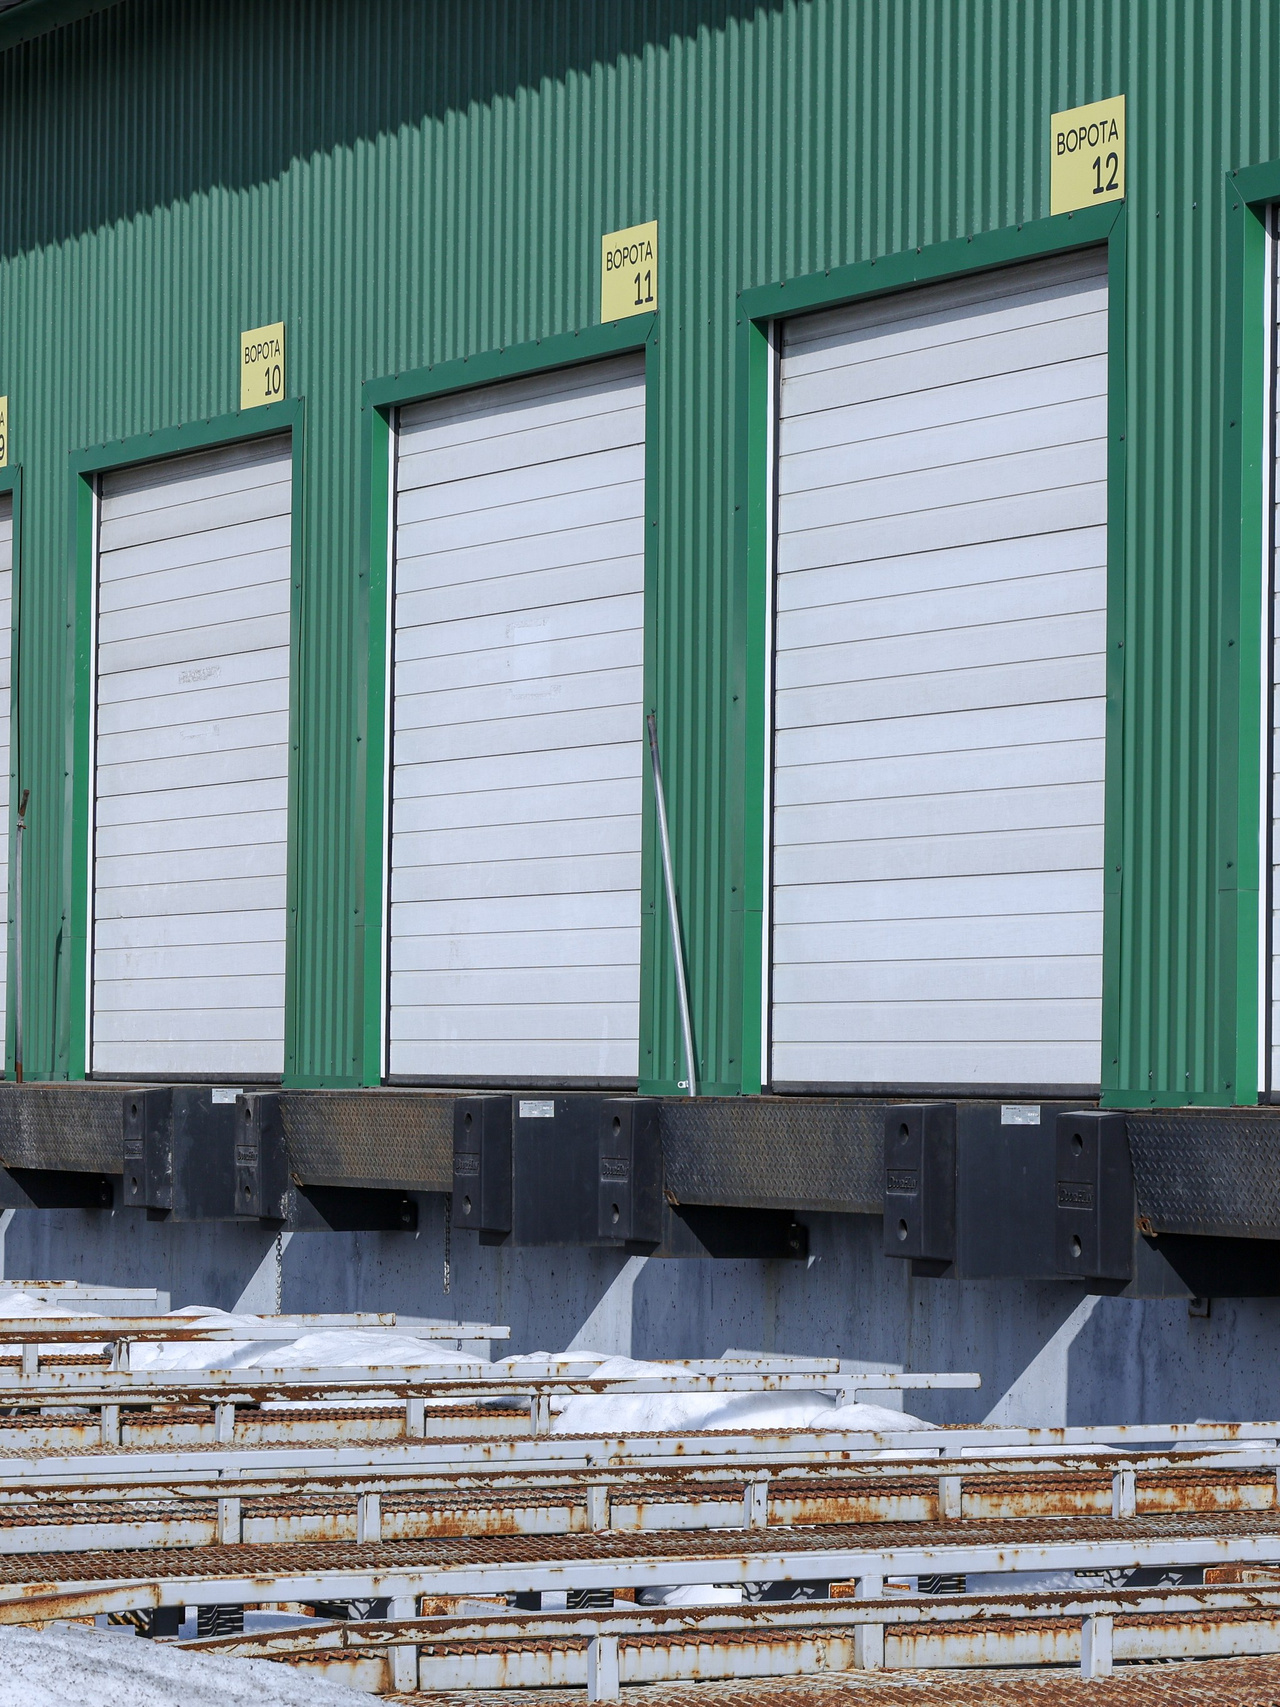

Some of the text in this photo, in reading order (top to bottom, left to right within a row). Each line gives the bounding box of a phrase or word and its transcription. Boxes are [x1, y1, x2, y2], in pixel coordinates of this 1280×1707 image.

[1057, 118, 1119, 156] ВОРОТА
[1092, 152, 1119, 195] 12
[606, 240, 654, 272] ВОРОТА
[634, 269, 654, 306] 11
[244, 339, 281, 365] ВОРОТА
[264, 364, 282, 397] 10
